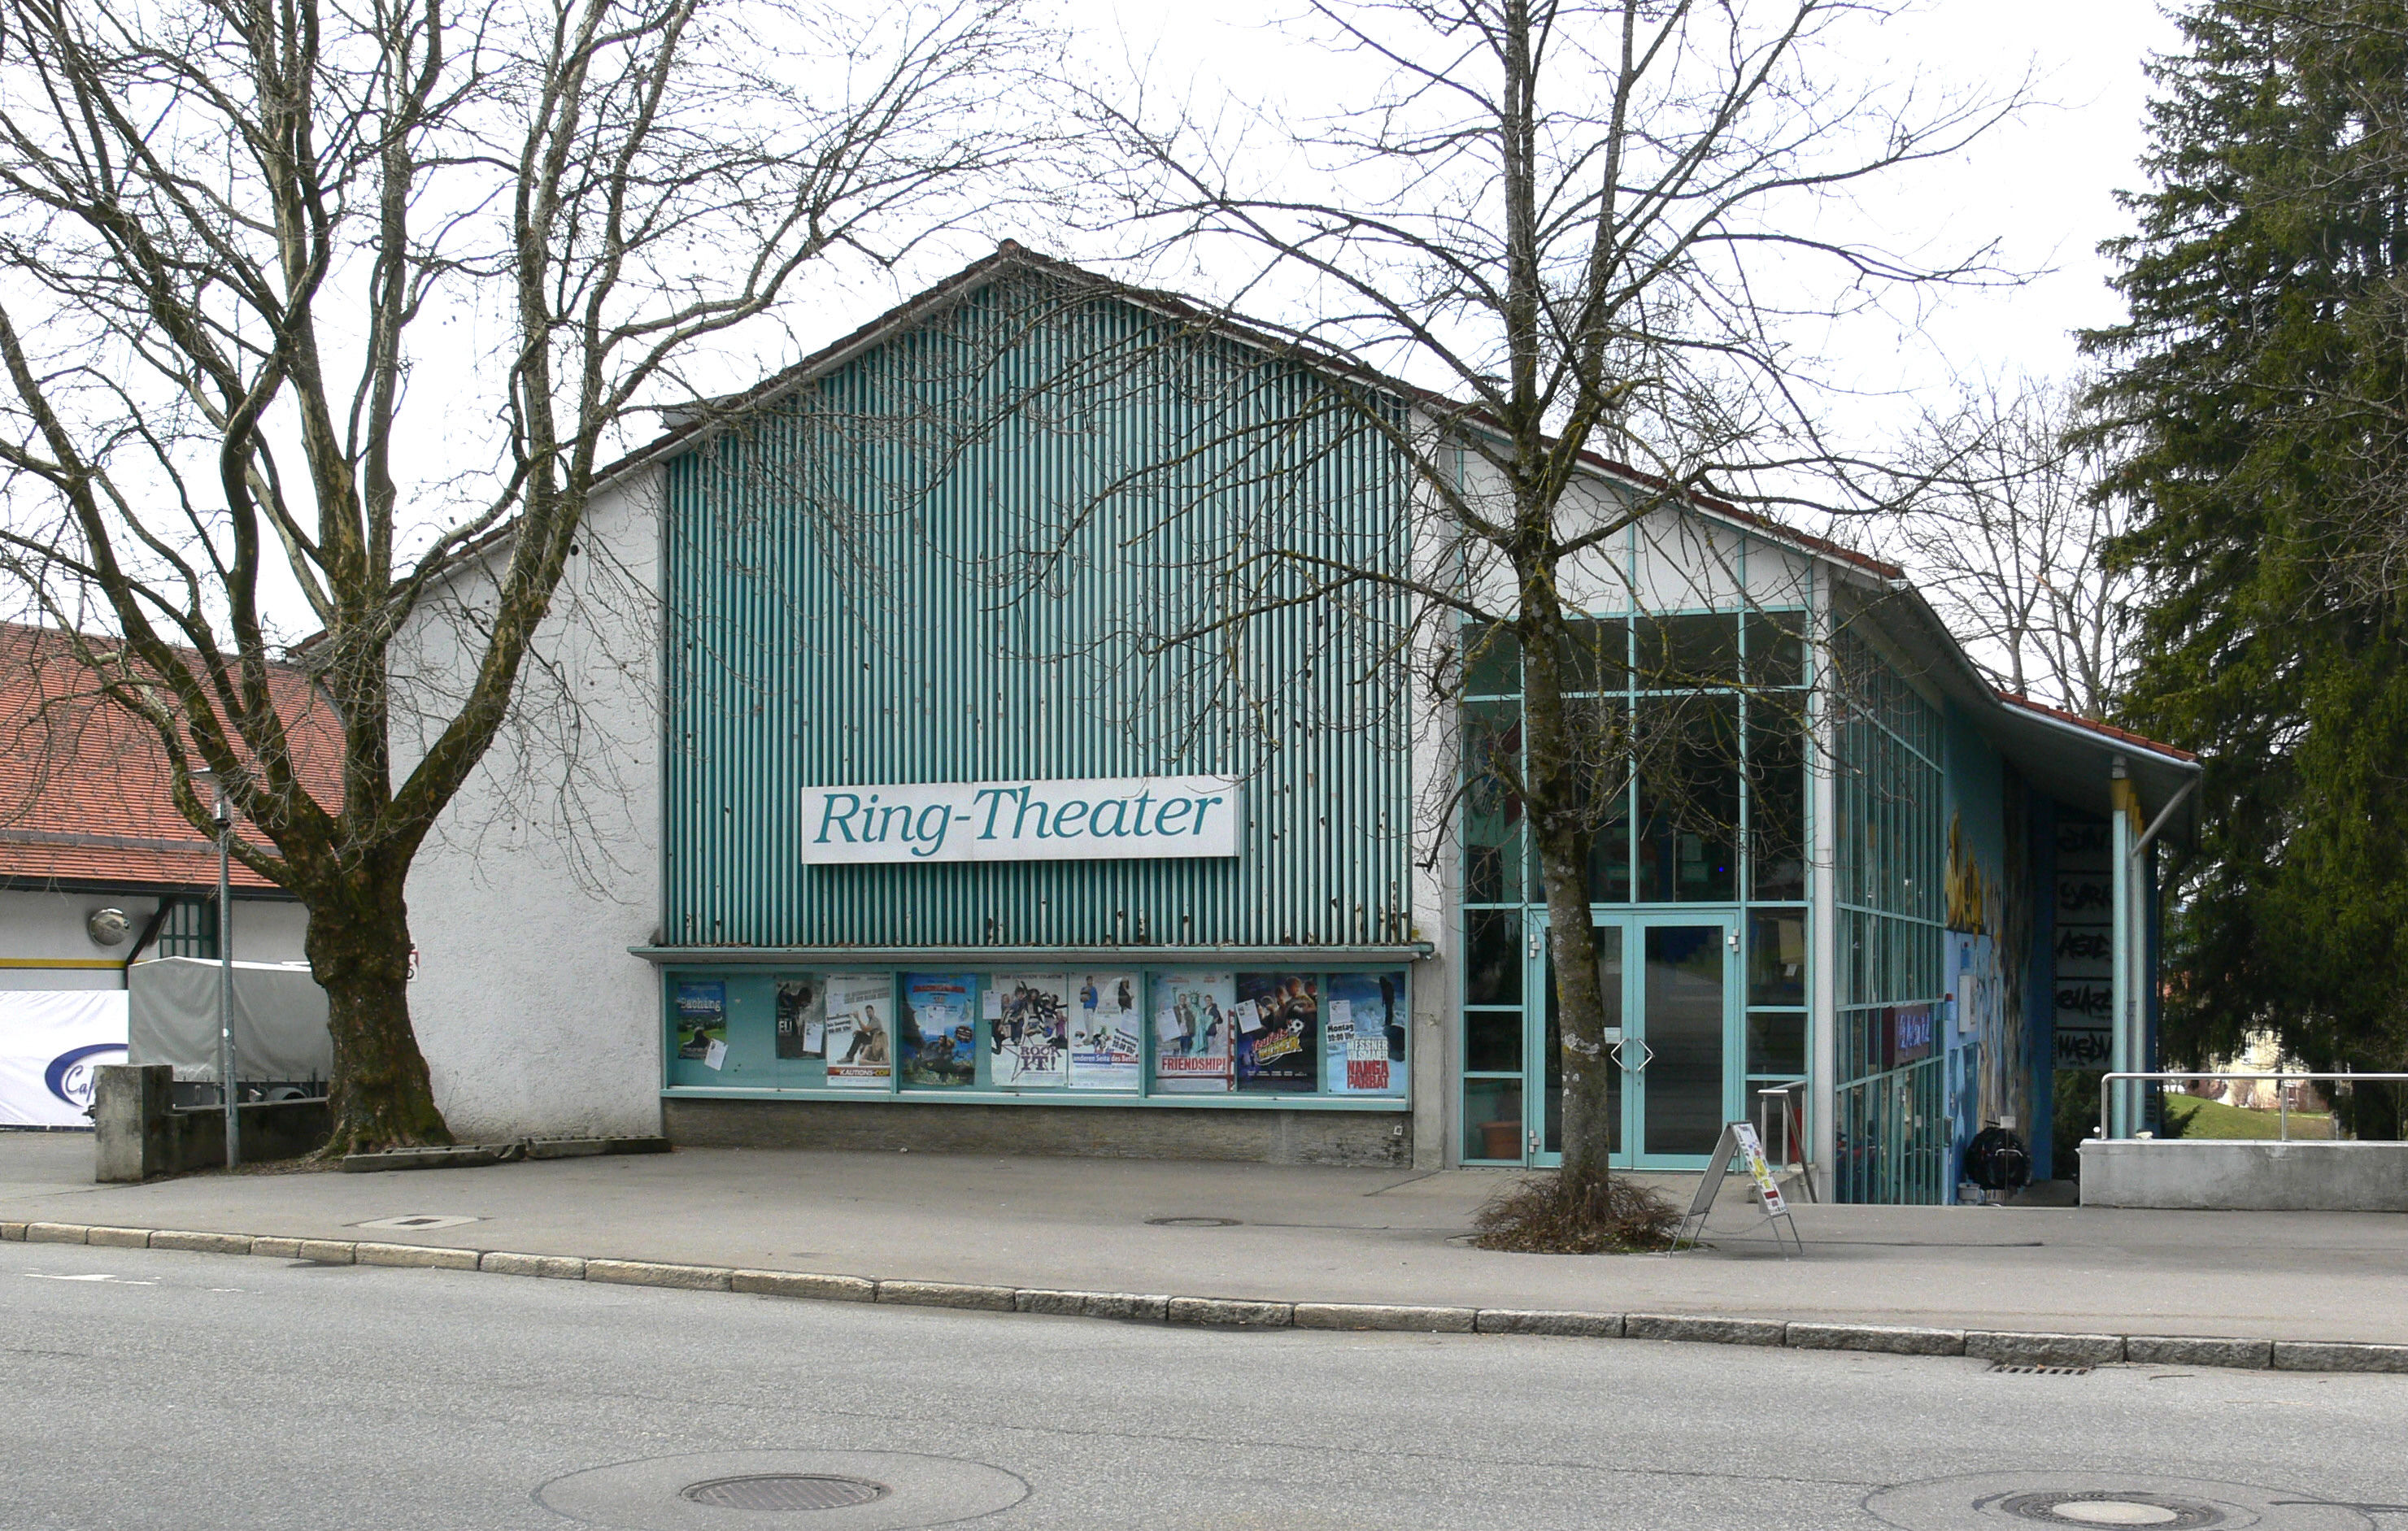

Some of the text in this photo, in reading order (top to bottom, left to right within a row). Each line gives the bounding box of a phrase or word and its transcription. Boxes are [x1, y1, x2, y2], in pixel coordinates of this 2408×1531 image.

[813, 786, 1222, 856] Ring-Theater
[1020, 1046, 1062, 1057] ROCK
[1347, 1039, 1388, 1050] MESSNER
[1021, 1055, 1056, 1071] IT!
[1161, 1057, 1226, 1071] FRIENDSHIP!
[1347, 1060, 1389, 1075] NANGA
[1347, 1075, 1388, 1089] PARBAT
